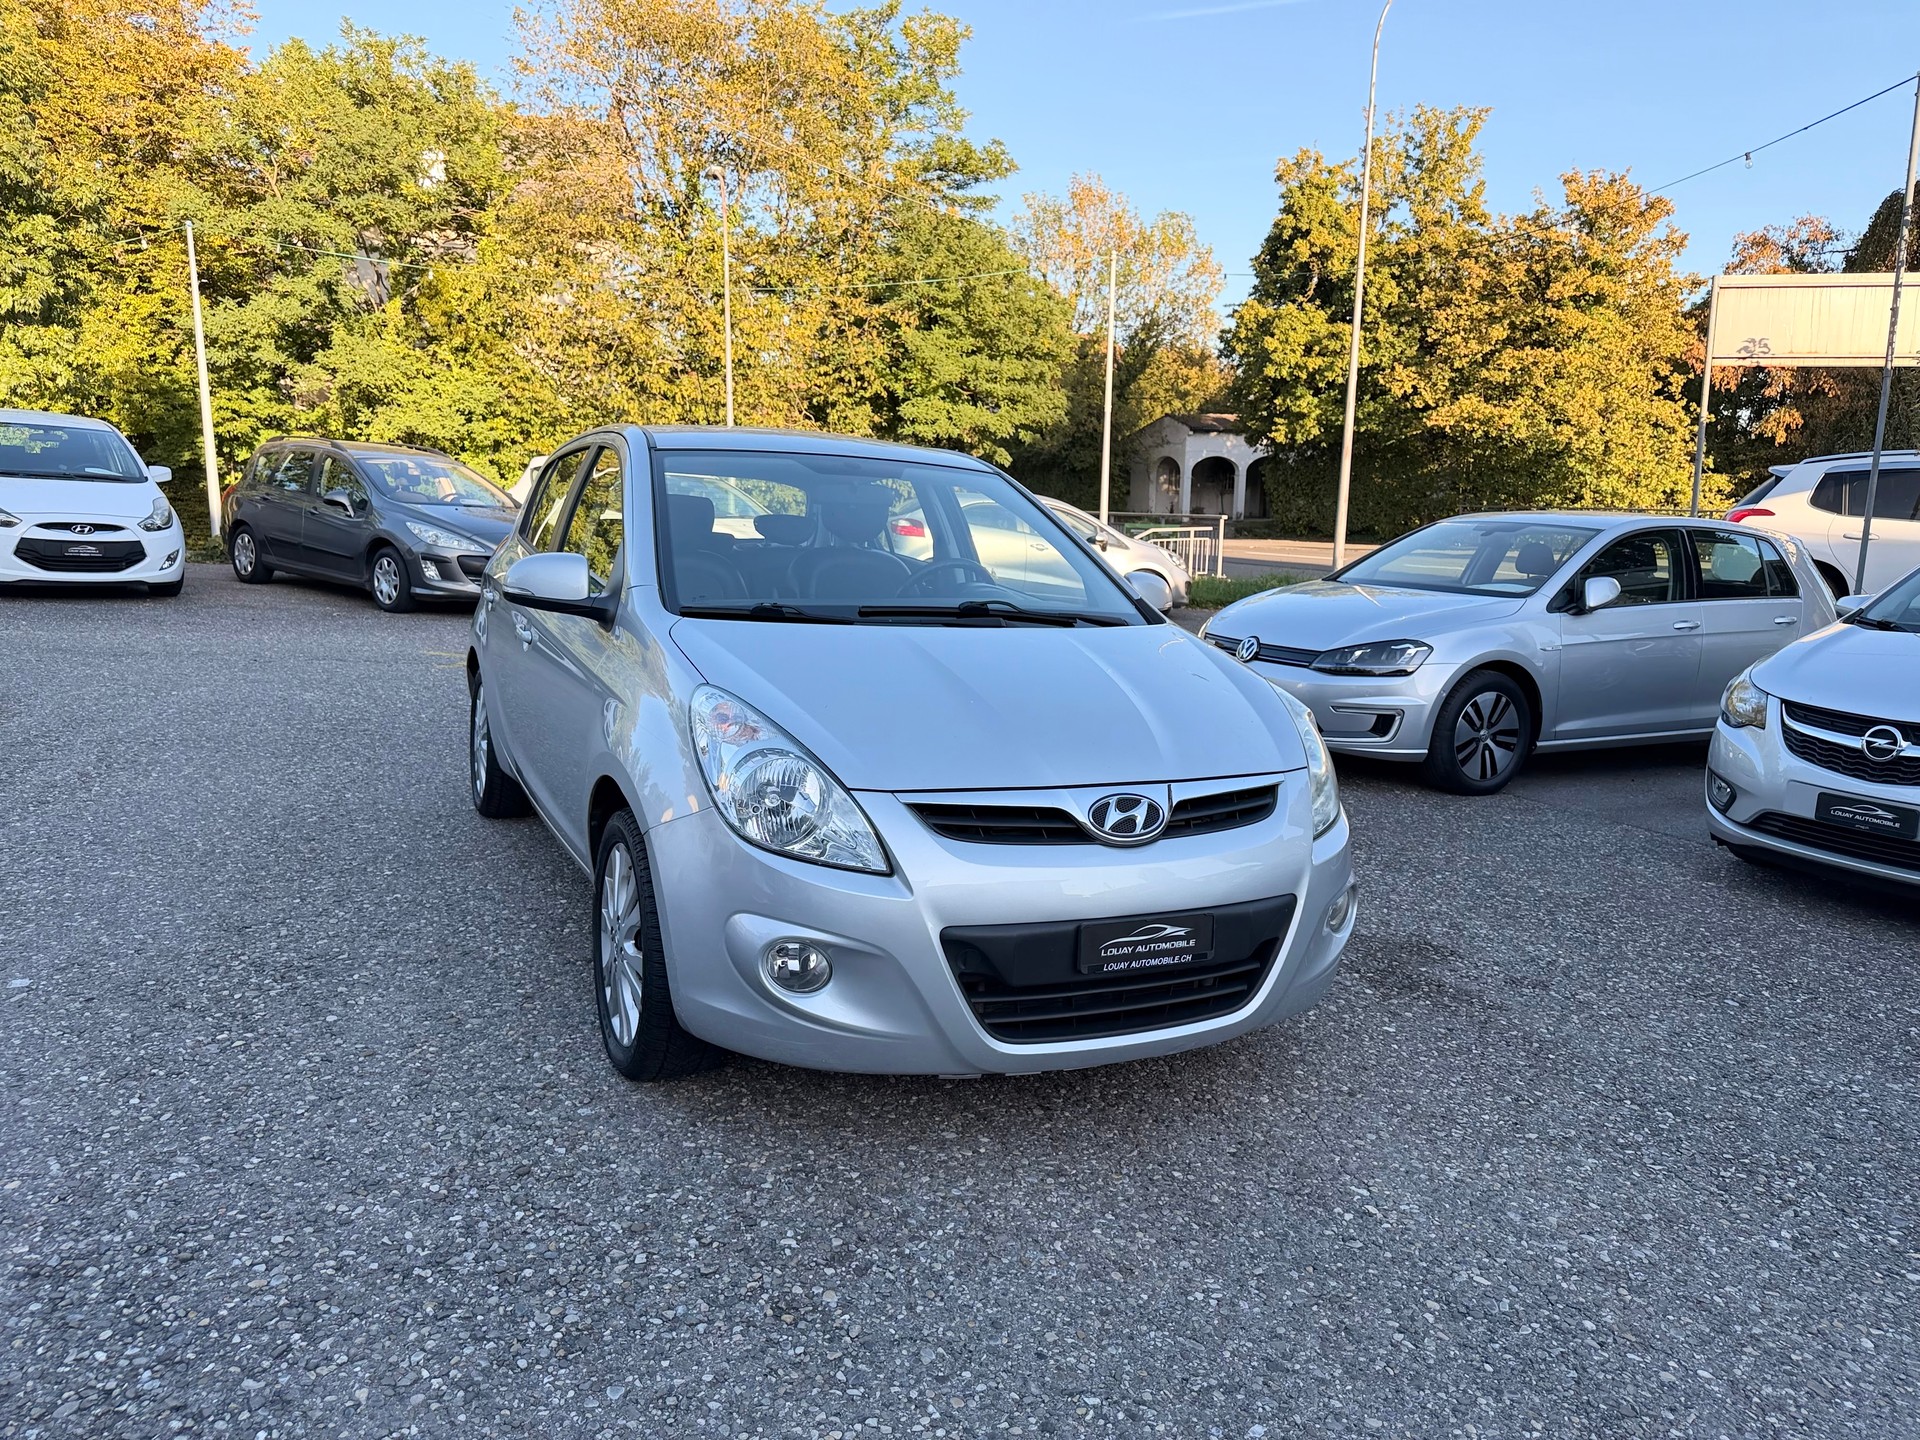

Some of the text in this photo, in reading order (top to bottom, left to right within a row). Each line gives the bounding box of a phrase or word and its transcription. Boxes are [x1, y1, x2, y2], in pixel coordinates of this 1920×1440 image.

[1237, 637, 1258, 660] VW
[1830, 809, 1854, 819] LOUAY
[1854, 814, 1901, 828] AUTOMOBILE
[1100, 939, 1196, 957] LOUAY AUTOMOBILE
[1103, 954, 1193, 972] LOUAY AUTOMOBILE.CH
